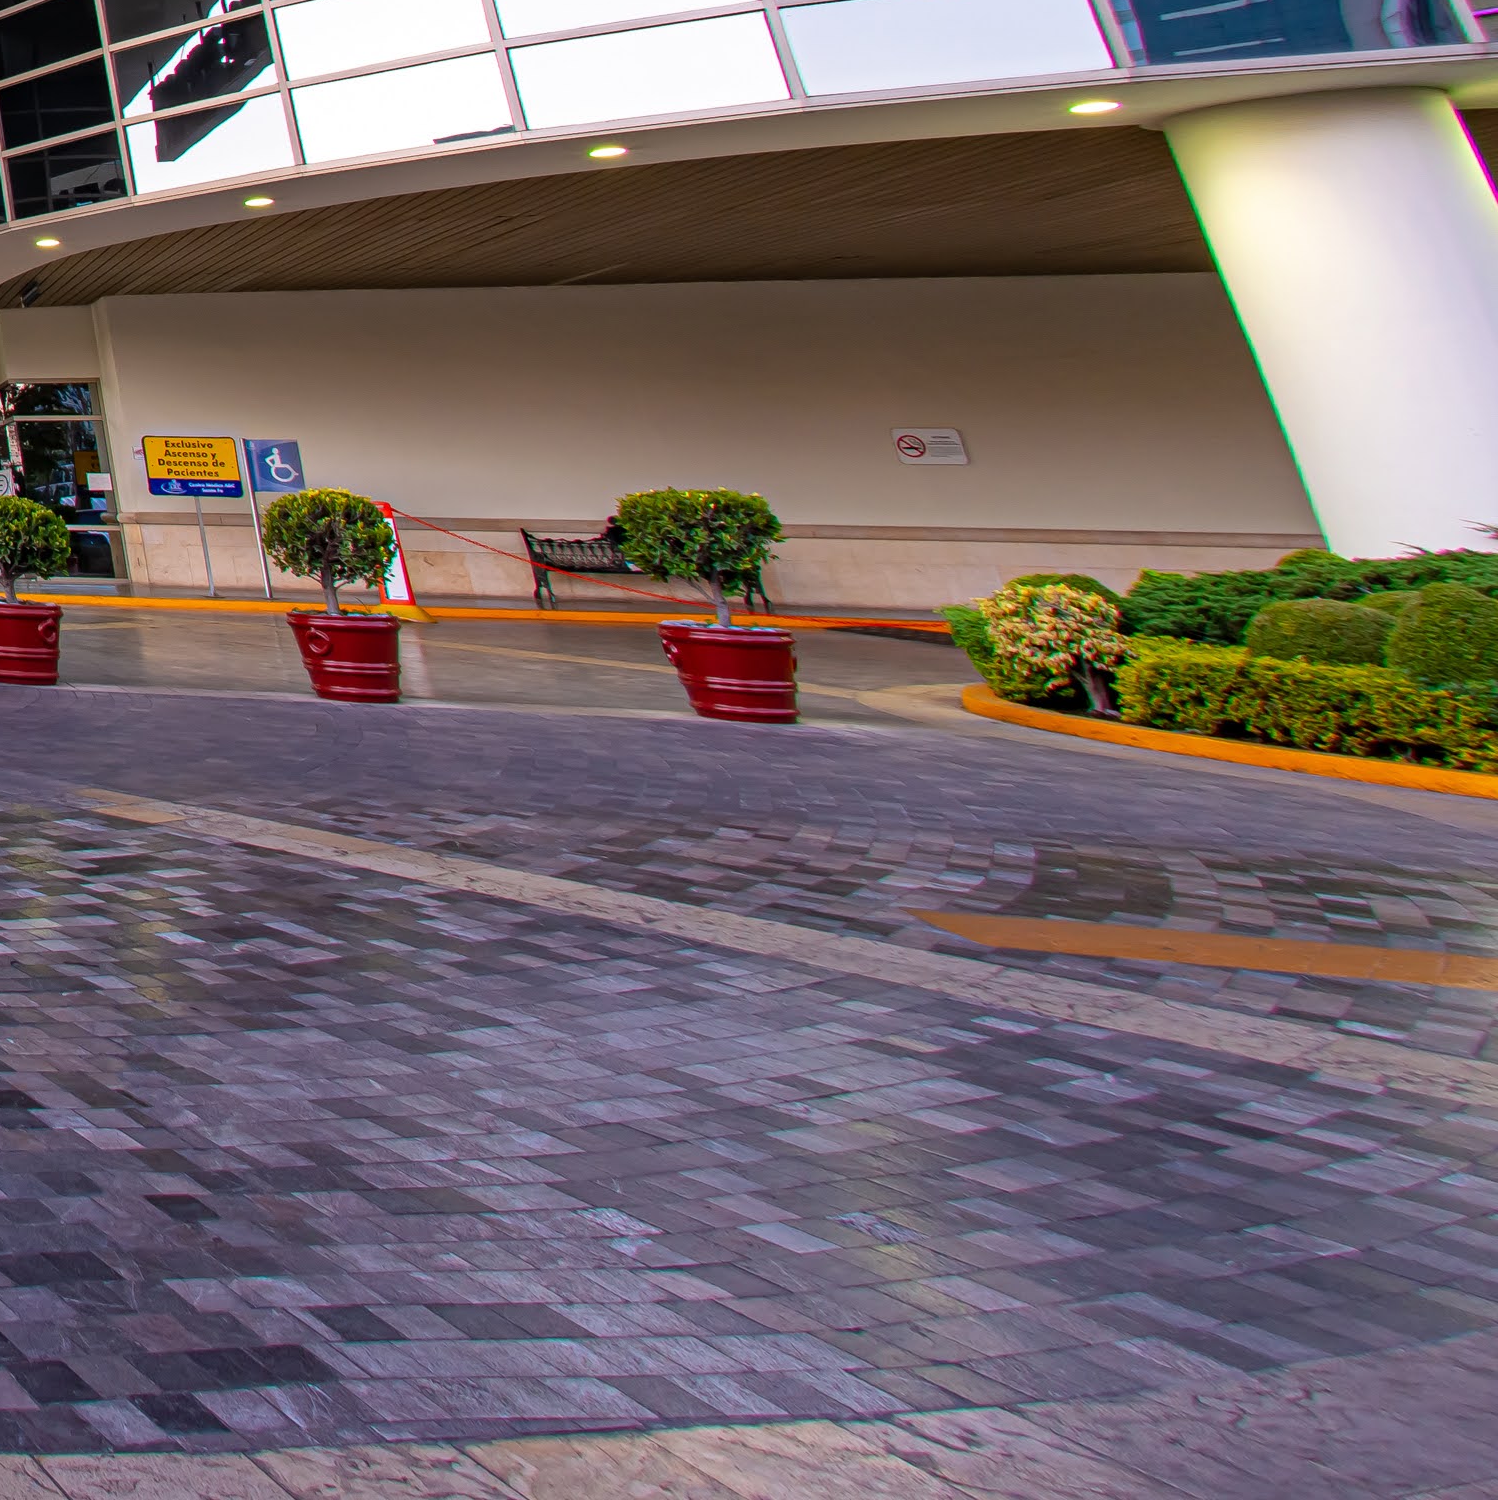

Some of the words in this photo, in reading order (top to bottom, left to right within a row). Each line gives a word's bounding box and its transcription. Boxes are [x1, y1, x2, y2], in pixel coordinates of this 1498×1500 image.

[164, 440, 214, 449] Exclusivo
[164, 449, 208, 458] Ascenso
[211, 452, 217, 460] y
[157, 458, 209, 467] Descenso
[211, 459, 226, 468] de
[167, 468, 219, 478] Pacientes
